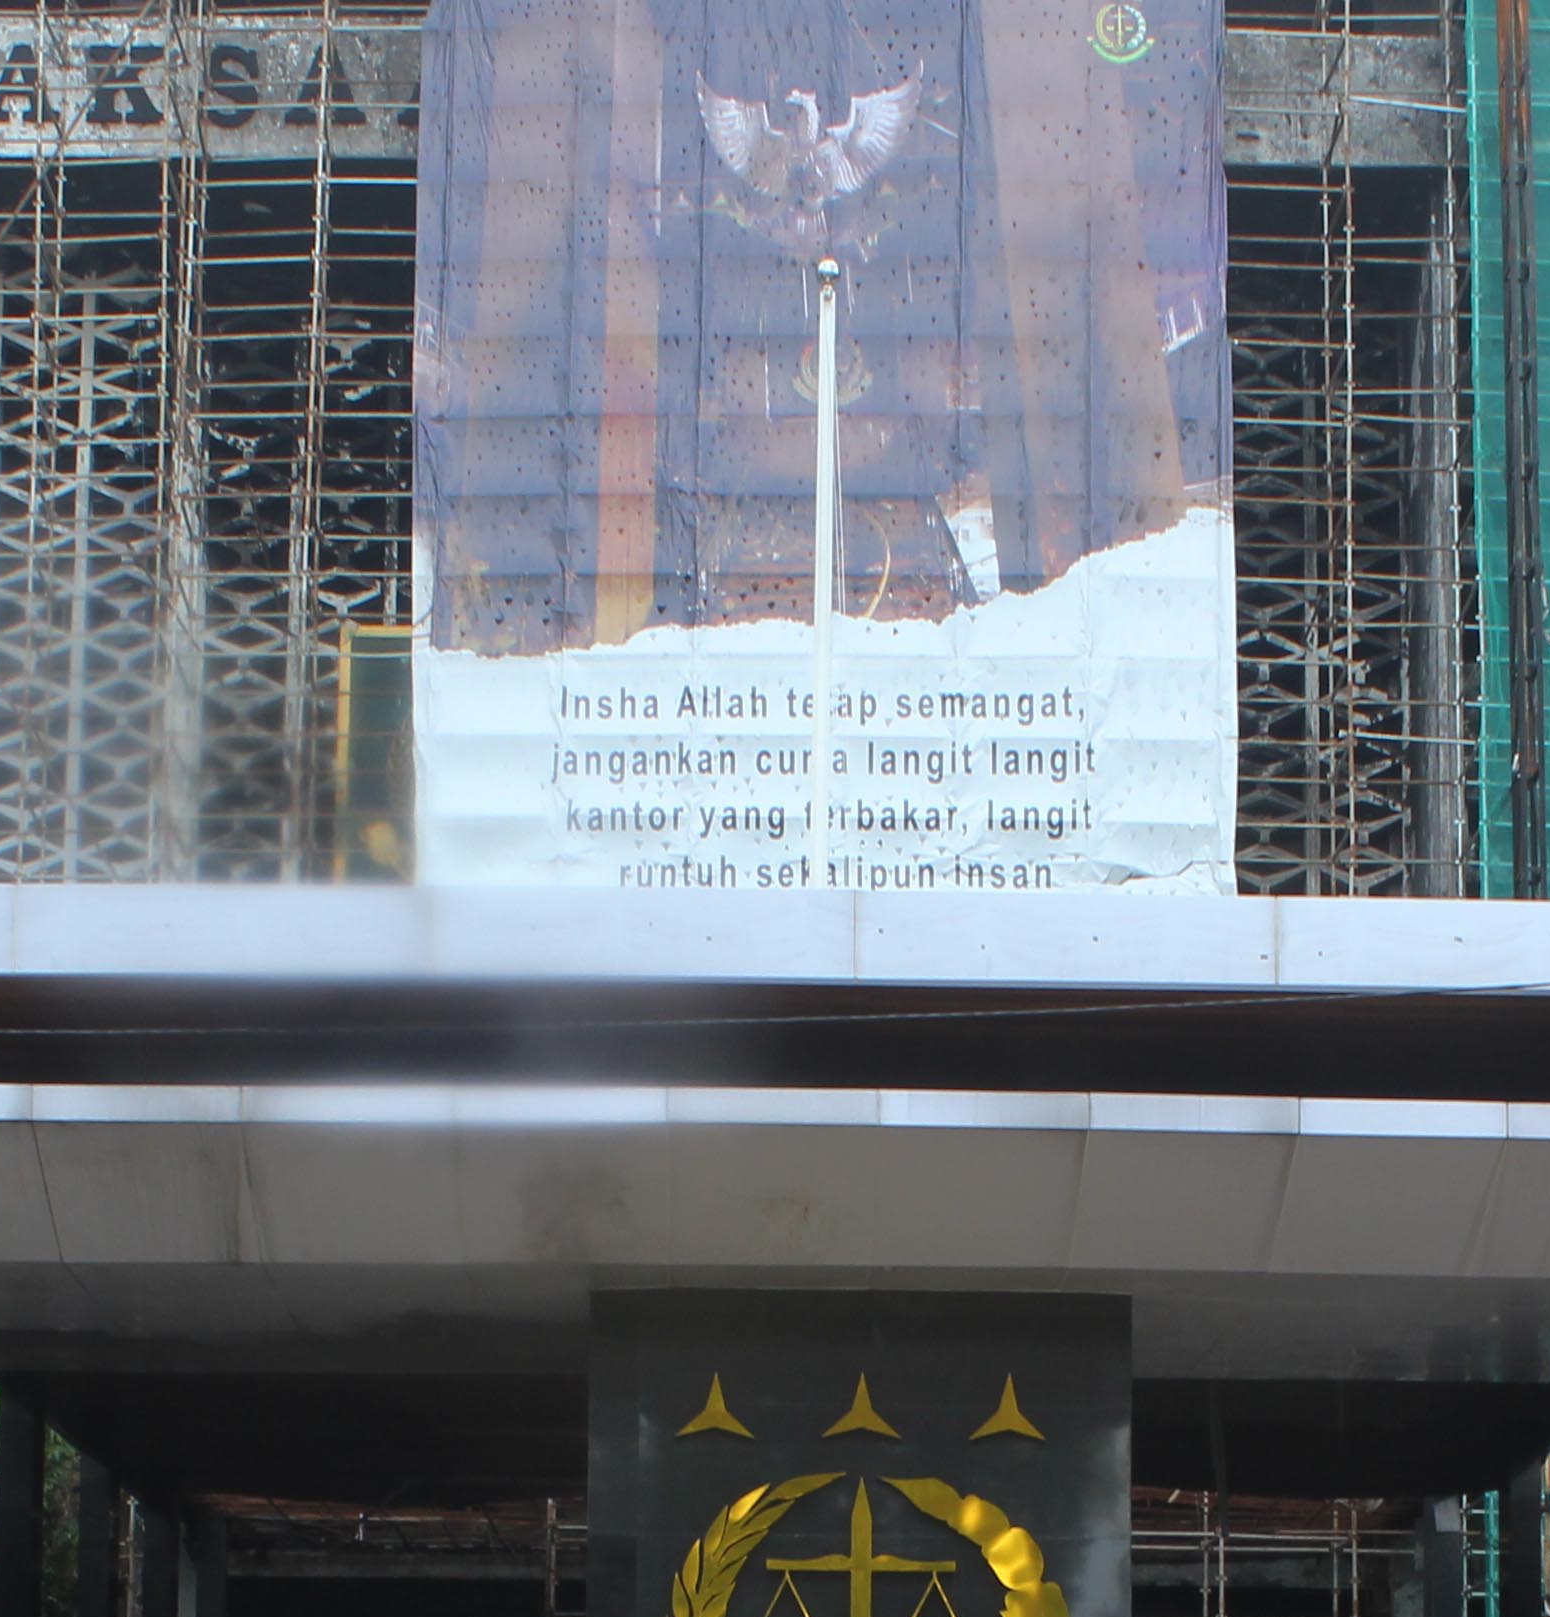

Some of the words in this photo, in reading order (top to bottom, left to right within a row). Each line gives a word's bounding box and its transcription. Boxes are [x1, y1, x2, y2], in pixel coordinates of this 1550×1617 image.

[560, 685, 659, 720] Insha
[676, 685, 768, 720] Allah
[786, 686, 877, 726] teap
[896, 686, 1086, 726] semangat,
[551, 742, 736, 784] jangankan
[868, 741, 973, 784] langit
[991, 740, 1096, 784] langit
[566, 800, 684, 832] kantor
[699, 804, 785, 839] yang
[987, 798, 1092, 839] langit
[620, 855, 737, 888] runtuh
[954, 854, 1052, 888] insan
